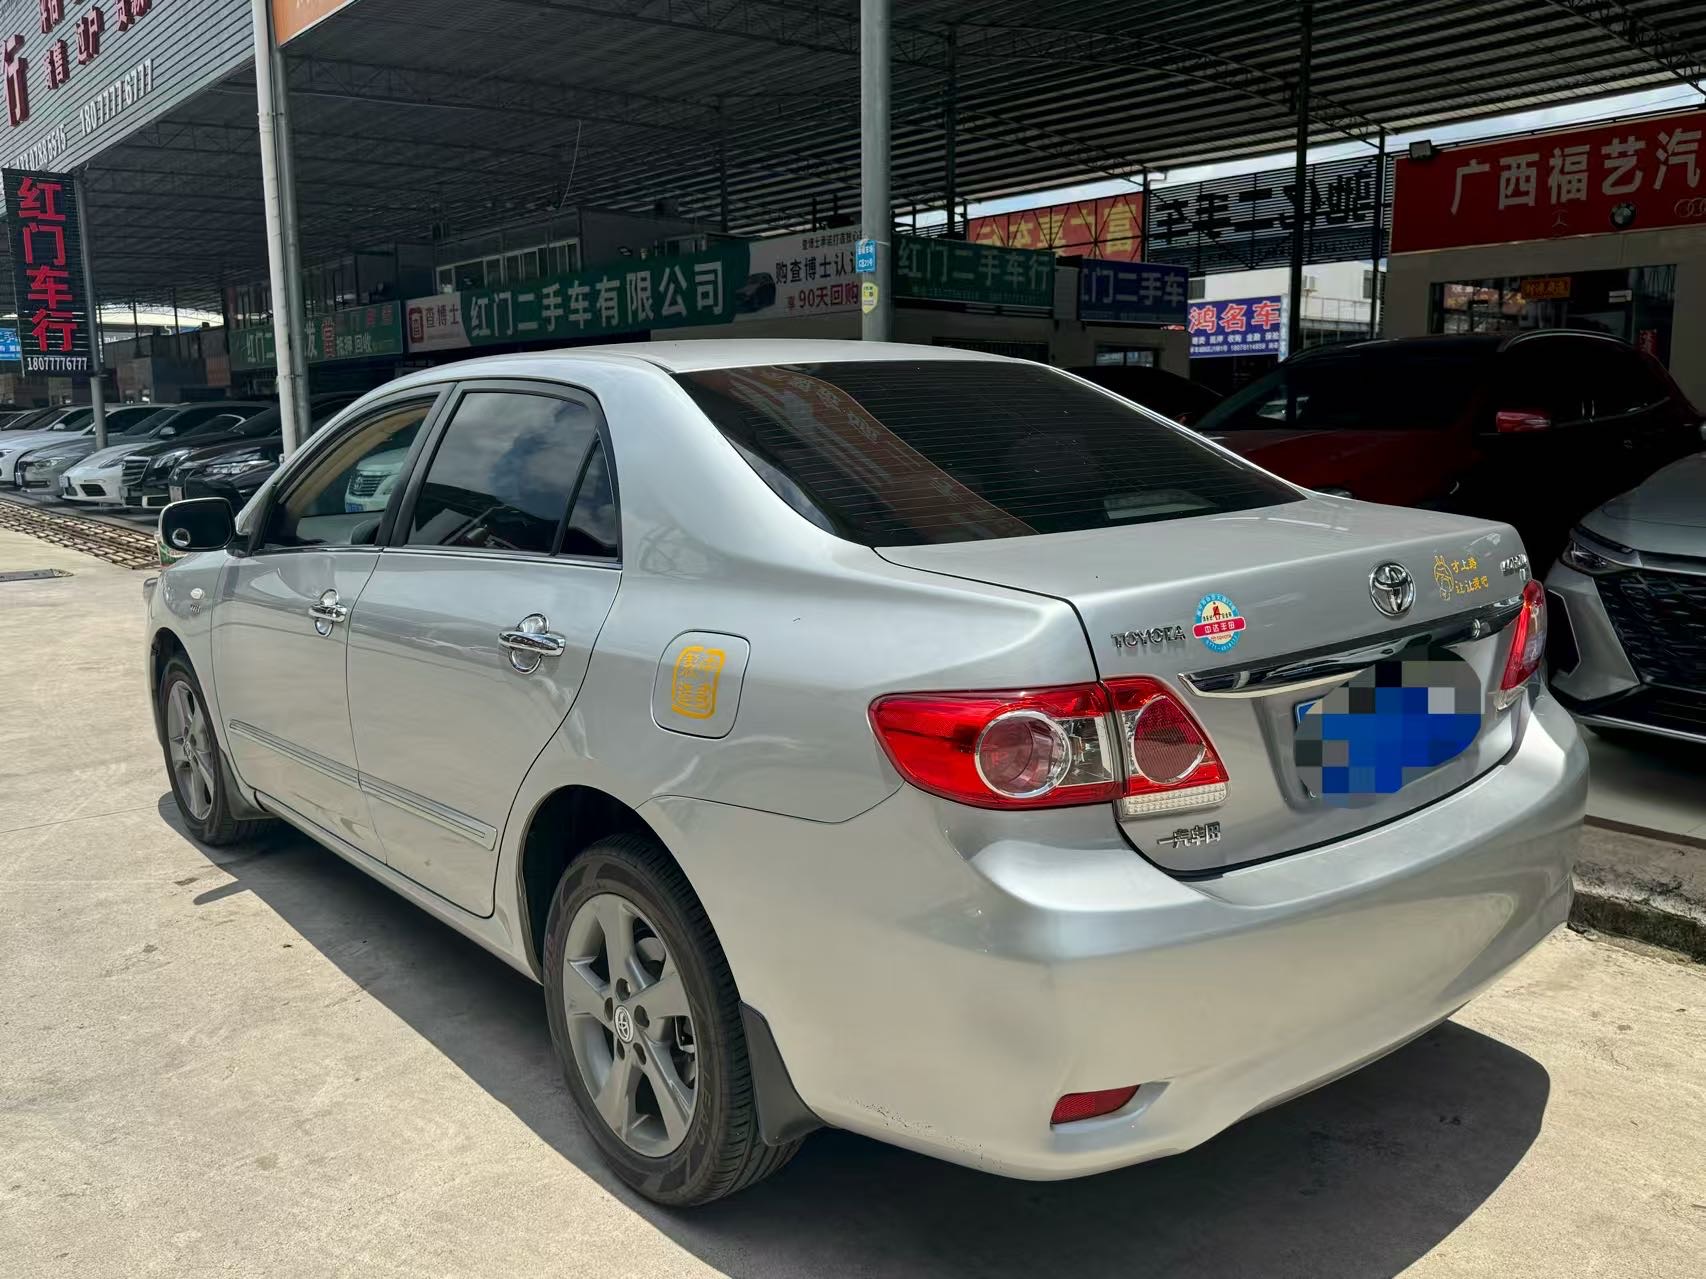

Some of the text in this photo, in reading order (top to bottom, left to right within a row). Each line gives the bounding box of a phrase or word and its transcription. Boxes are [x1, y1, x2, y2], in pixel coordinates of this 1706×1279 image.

[1450, 127, 1702, 216] 广西福艺汽
[18, 176, 78, 352] 红门车行
[897, 238, 1052, 291] 红门二手车行
[469, 260, 723, 338] 红门二手车有限公司
[27, 357, 88, 370] 18077776777
[1110, 625, 1187, 649] TOYOTA
